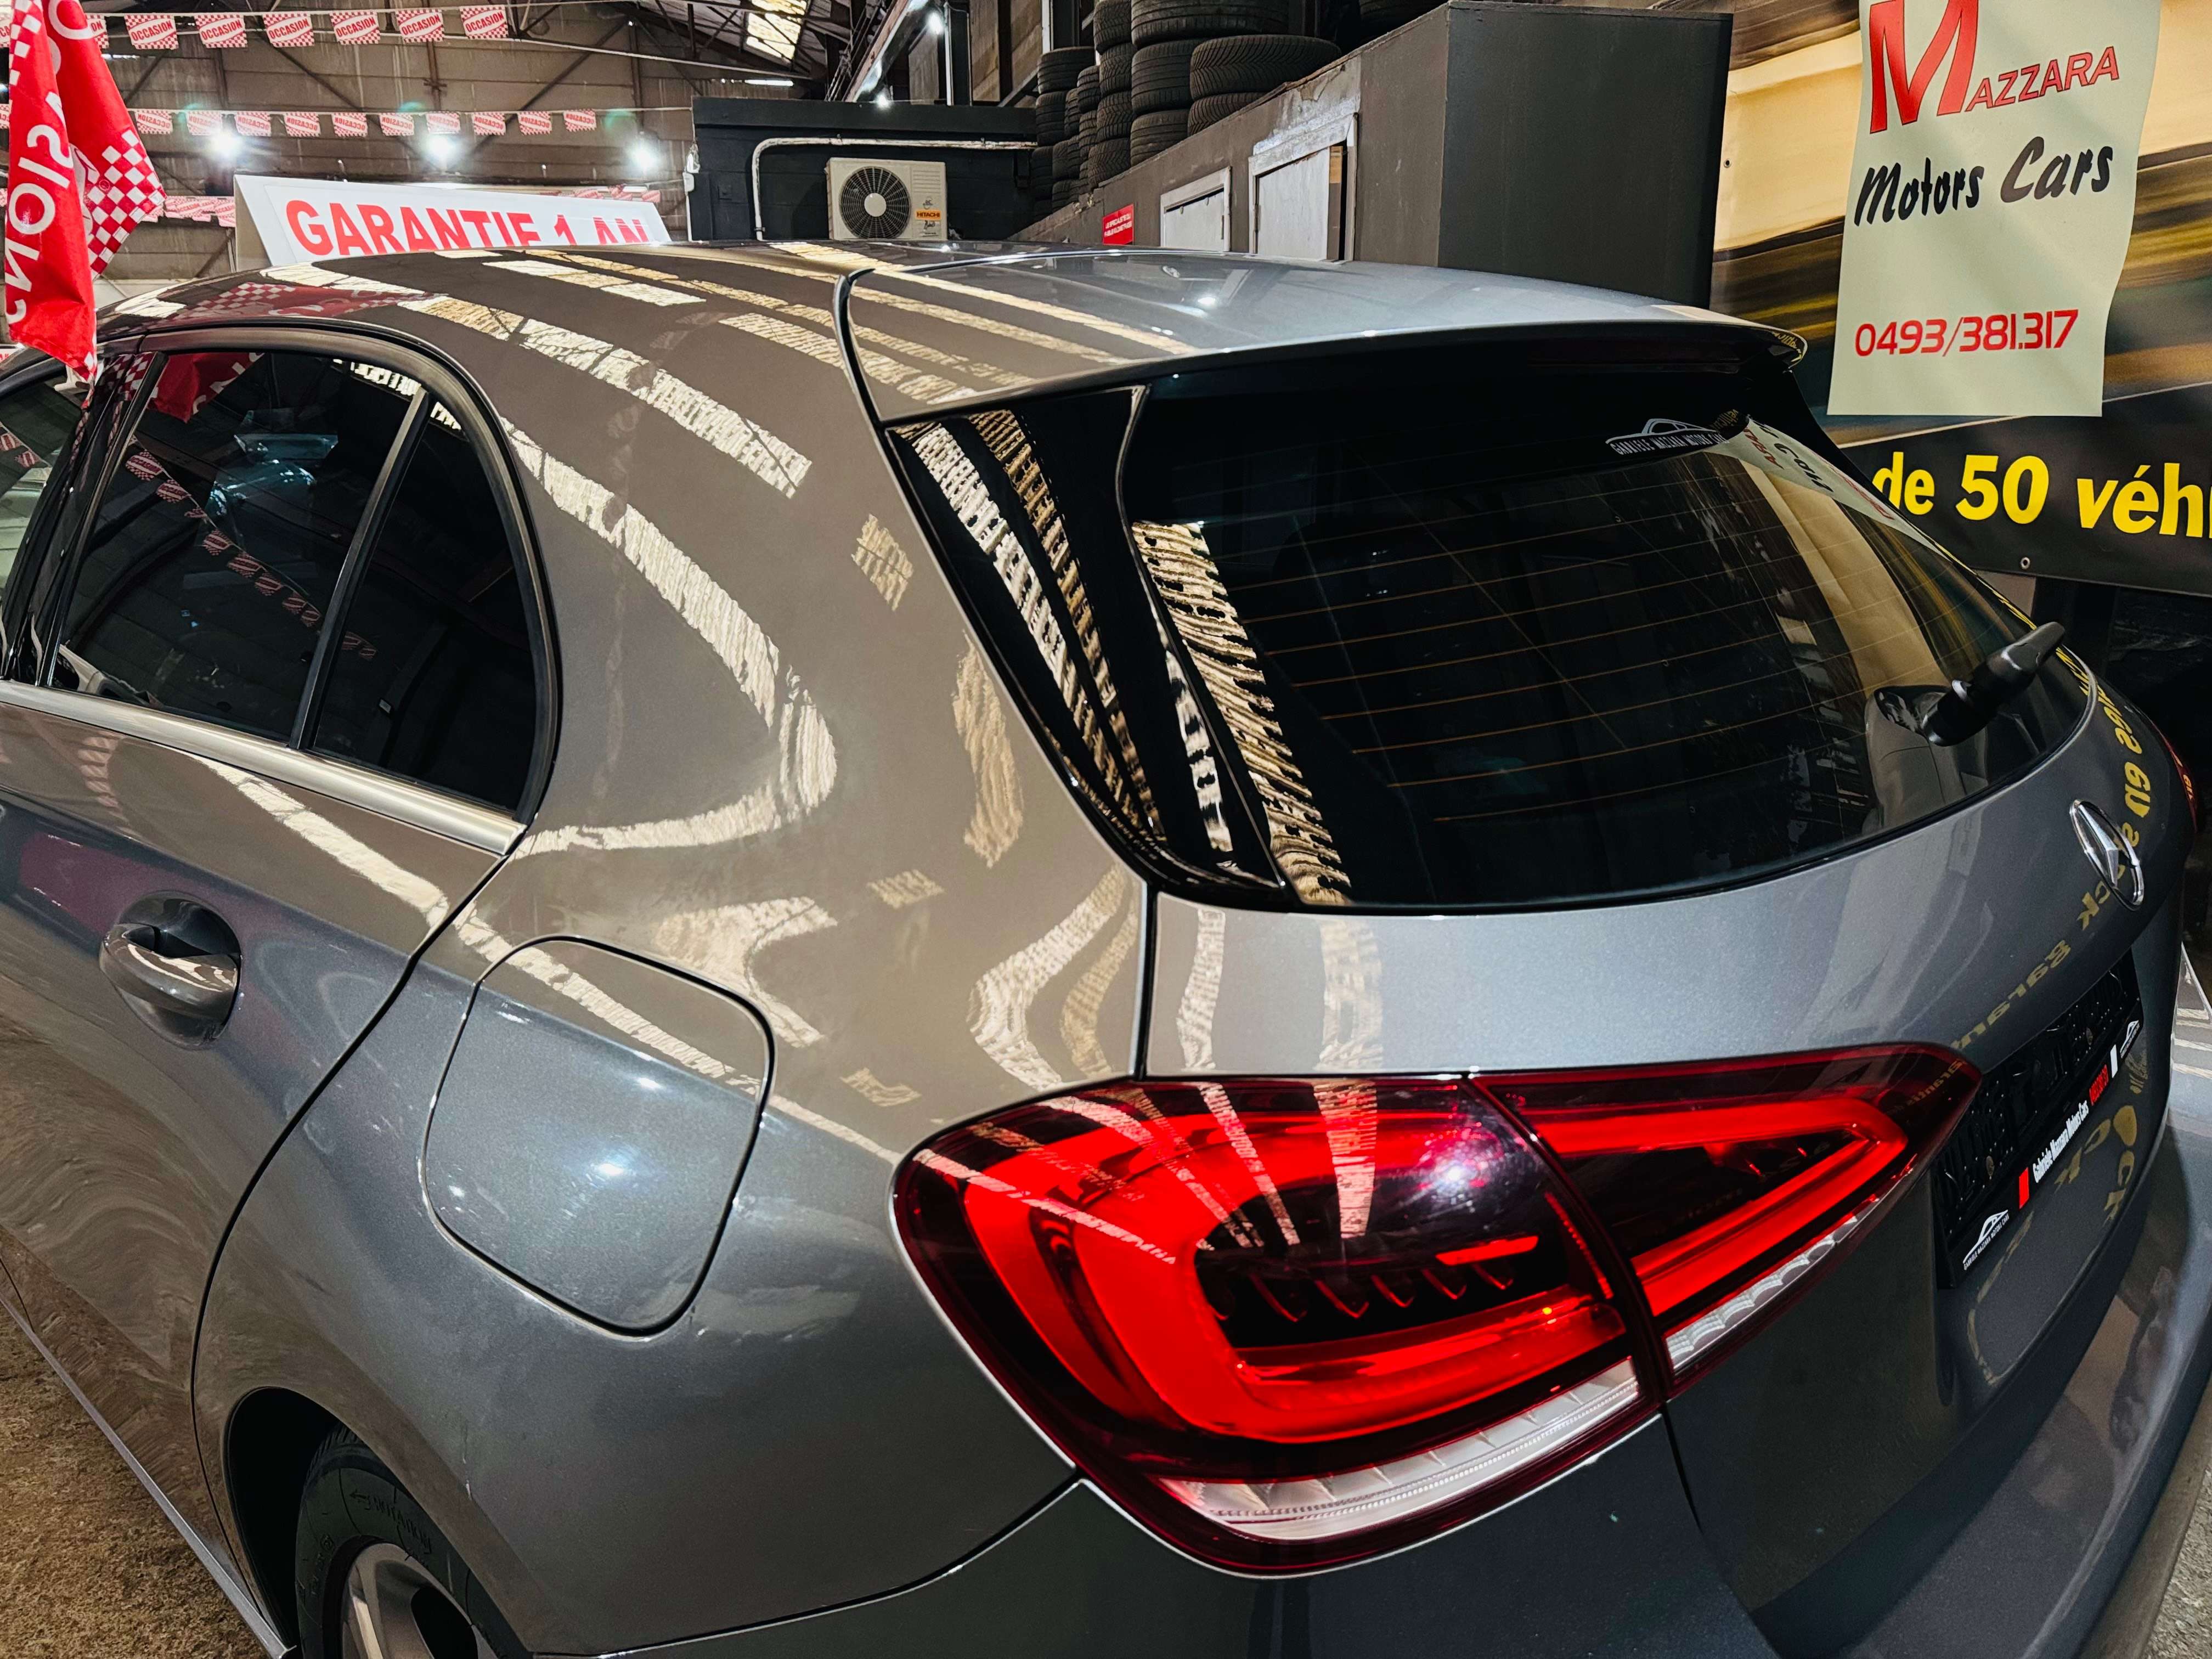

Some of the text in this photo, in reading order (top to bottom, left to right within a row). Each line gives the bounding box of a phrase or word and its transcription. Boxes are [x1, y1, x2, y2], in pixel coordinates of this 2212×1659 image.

[131, 20, 173, 41] OCCASION
[201, 20, 242, 40] OCCASION
[269, 19, 309, 39] OCCASION
[336, 16, 376, 37] OCCASION
[402, 14, 441, 35] OCCASION
[466, 12, 504, 32] OCCASION
[1869, 0, 2120, 134] MAZZARA
[1854, 137, 2113, 226] Motors Cars
[286, 200, 649, 256] GARANTIE 1 AN
[1855, 309, 2079, 357] 0493/381.317
[1872, 452, 1934, 515] de
[1956, 454, 2049, 524] 50
[2077, 462, 2212, 538] véh
